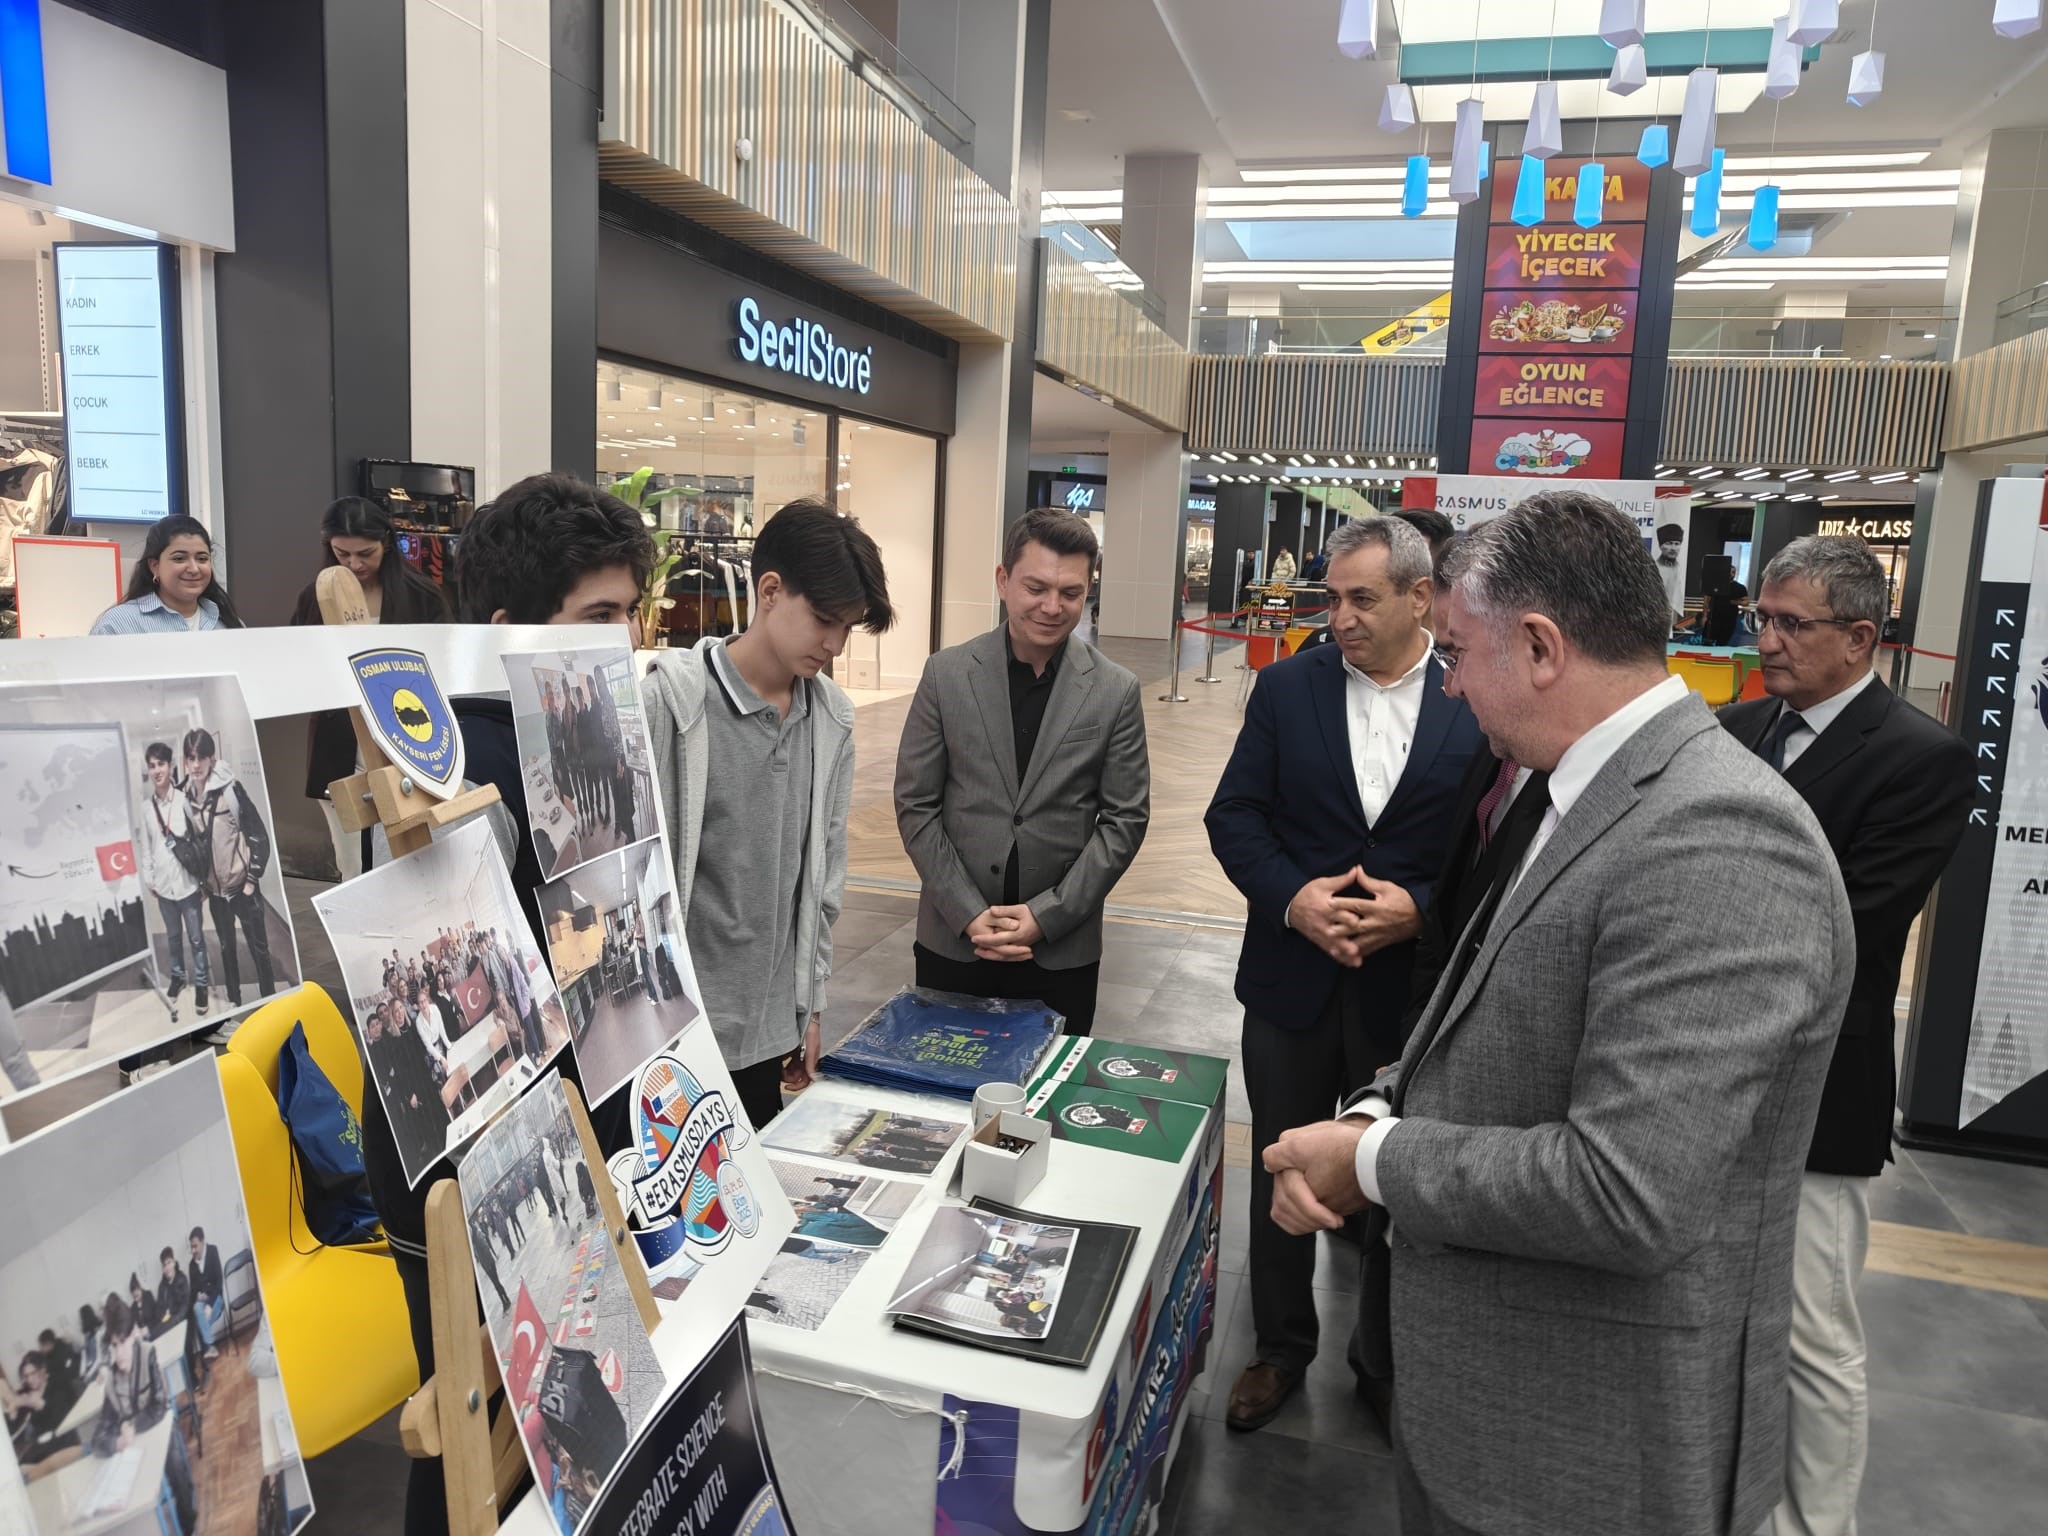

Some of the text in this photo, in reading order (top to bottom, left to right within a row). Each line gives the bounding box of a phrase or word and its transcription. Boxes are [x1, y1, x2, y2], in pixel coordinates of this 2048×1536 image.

[1516, 229, 1616, 252] YİYECEK
[1521, 254, 1607, 281] İÇECEK
[66, 298, 96, 308] KADIN
[70, 345, 100, 356] ERKEK
[1521, 363, 1586, 381] OYUN
[73, 396, 108, 410] ÇOCUK
[1499, 382, 1604, 407] EĞLENCE
[77, 457, 109, 469] BEBEK
[1615, 499, 1655, 512] ÜNLE
[1862, 520, 1912, 538] CLASS
[360, 659, 426, 678] OSMAN ULUBAŞ
[391, 732, 428, 761] KAYSERİ
[429, 748, 443, 761] FEN
[920, 1036, 990, 1053] OF IDEAS
[915, 1051, 978, 1067] SCHOOL
[947, 1048, 983, 1060] FULL
[647, 1101, 725, 1209] #ERASMUSDAYS
[676, 1391, 727, 1479] SCIENCE
[694, 1463, 728, 1530] WITH
